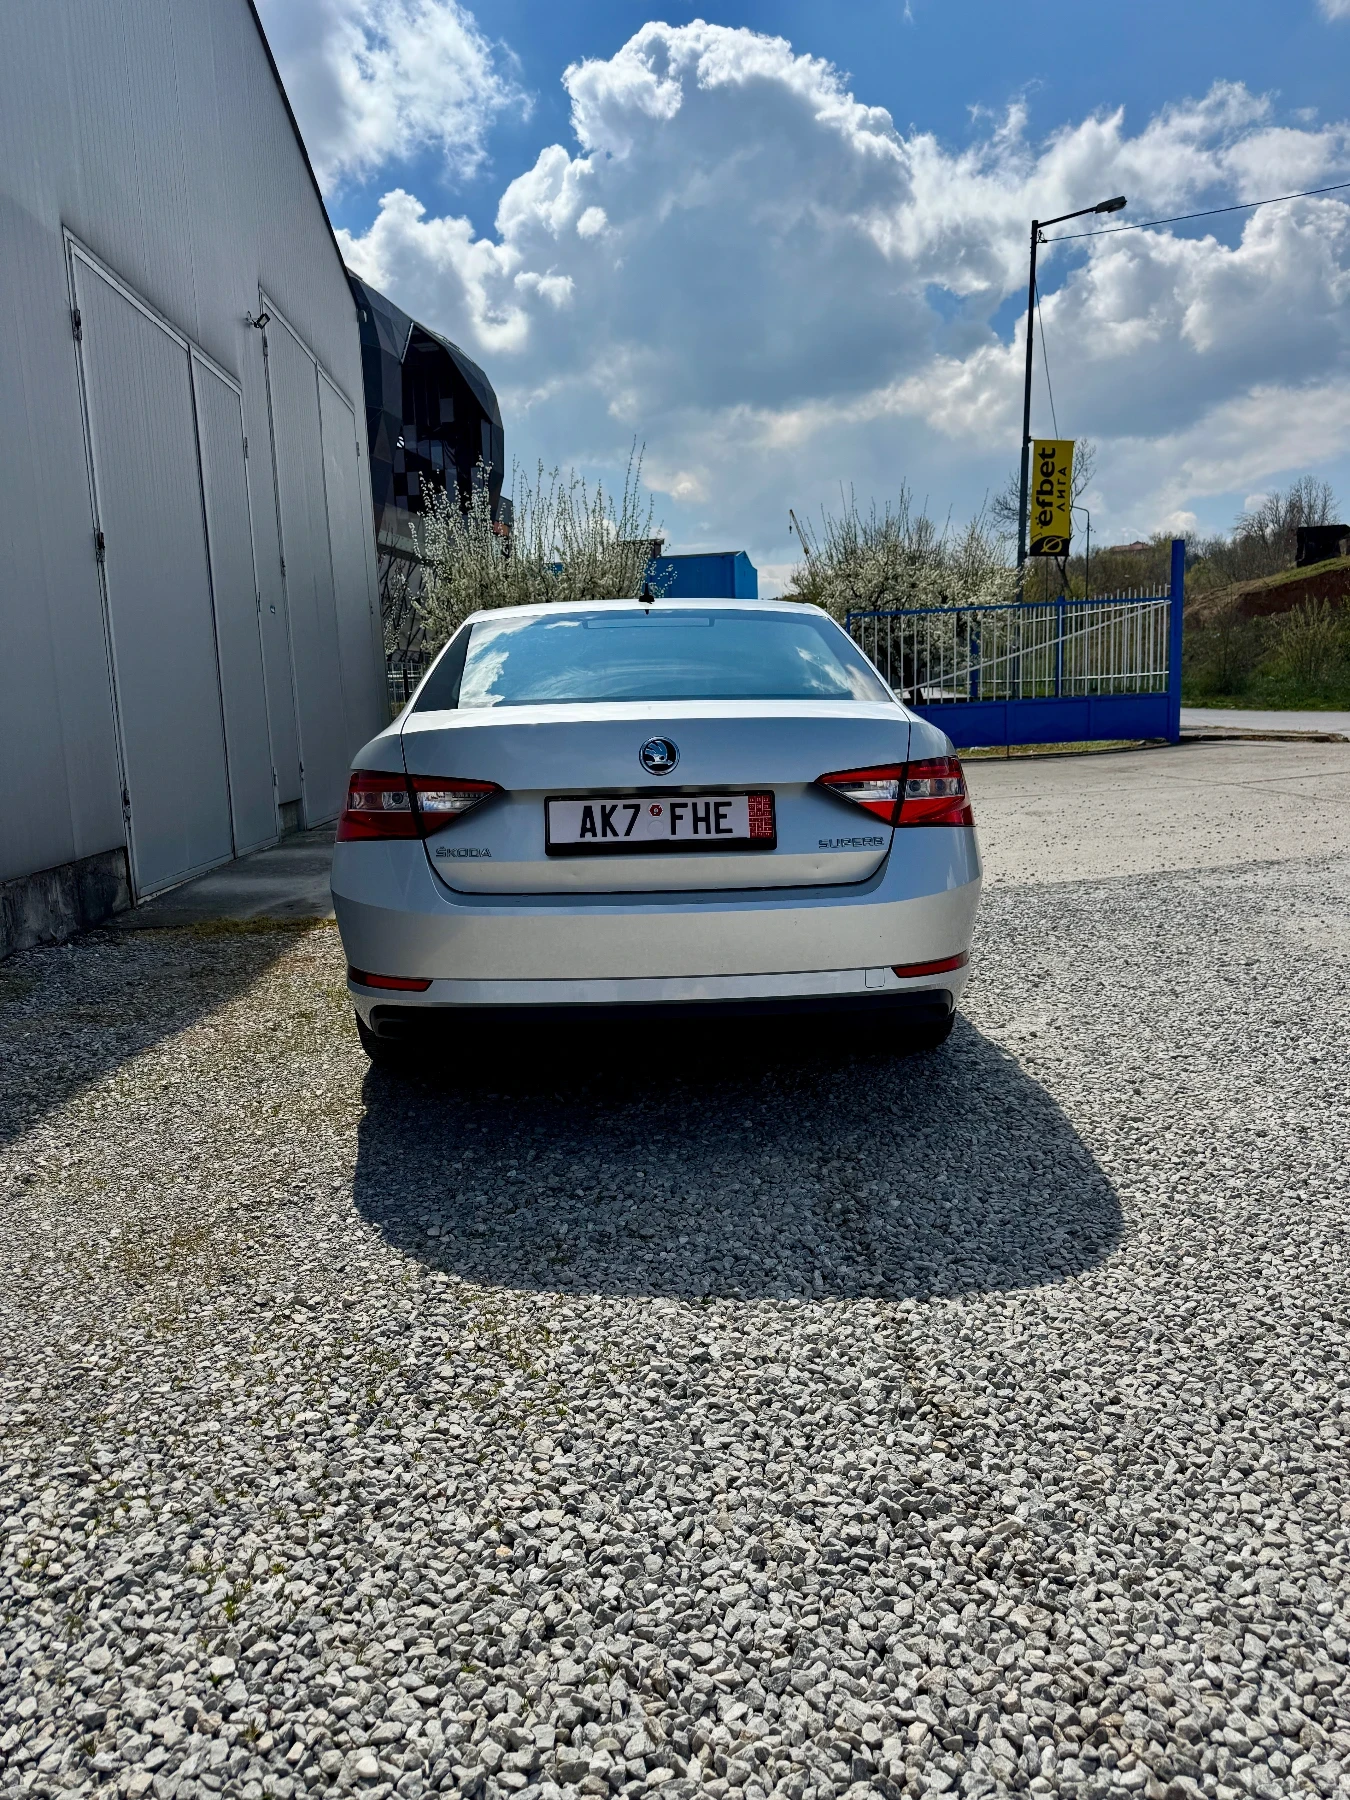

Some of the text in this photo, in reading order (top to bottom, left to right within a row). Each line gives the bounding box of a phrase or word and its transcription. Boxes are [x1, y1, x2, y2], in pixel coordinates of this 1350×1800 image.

[1035, 447, 1056, 528] efbet
[1056, 466, 1068, 512] ЛИГА
[579, 803, 642, 839] AK7
[669, 801, 734, 836] FHE
[818, 836, 885, 849] SUPERB
